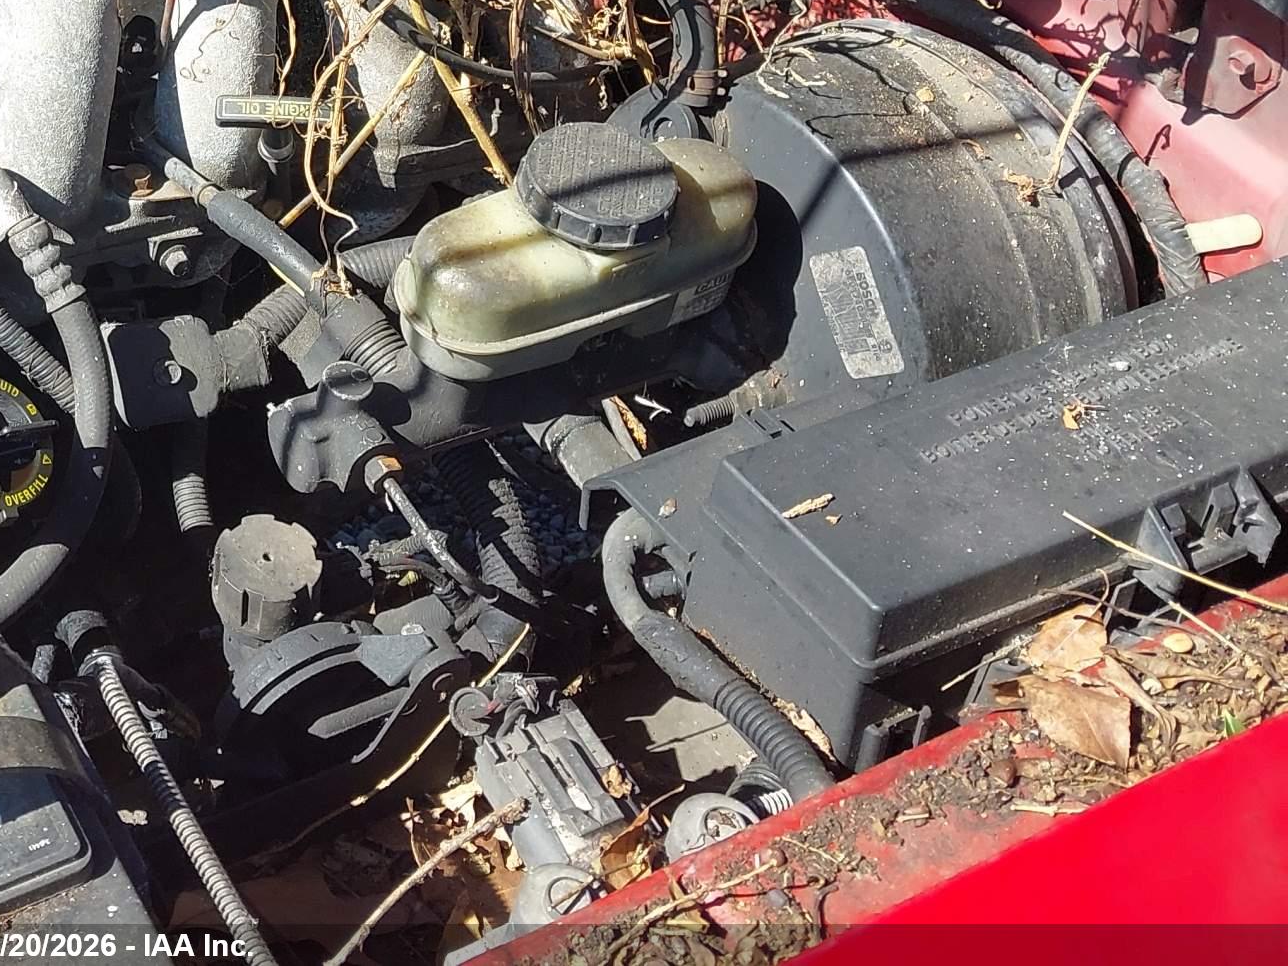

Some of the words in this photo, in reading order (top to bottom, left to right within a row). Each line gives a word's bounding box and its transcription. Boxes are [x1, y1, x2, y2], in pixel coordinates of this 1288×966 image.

[237, 102, 259, 113] OIL
[855, 271, 880, 319] BOSCH
[4, 473, 49, 507] OVERFILL
